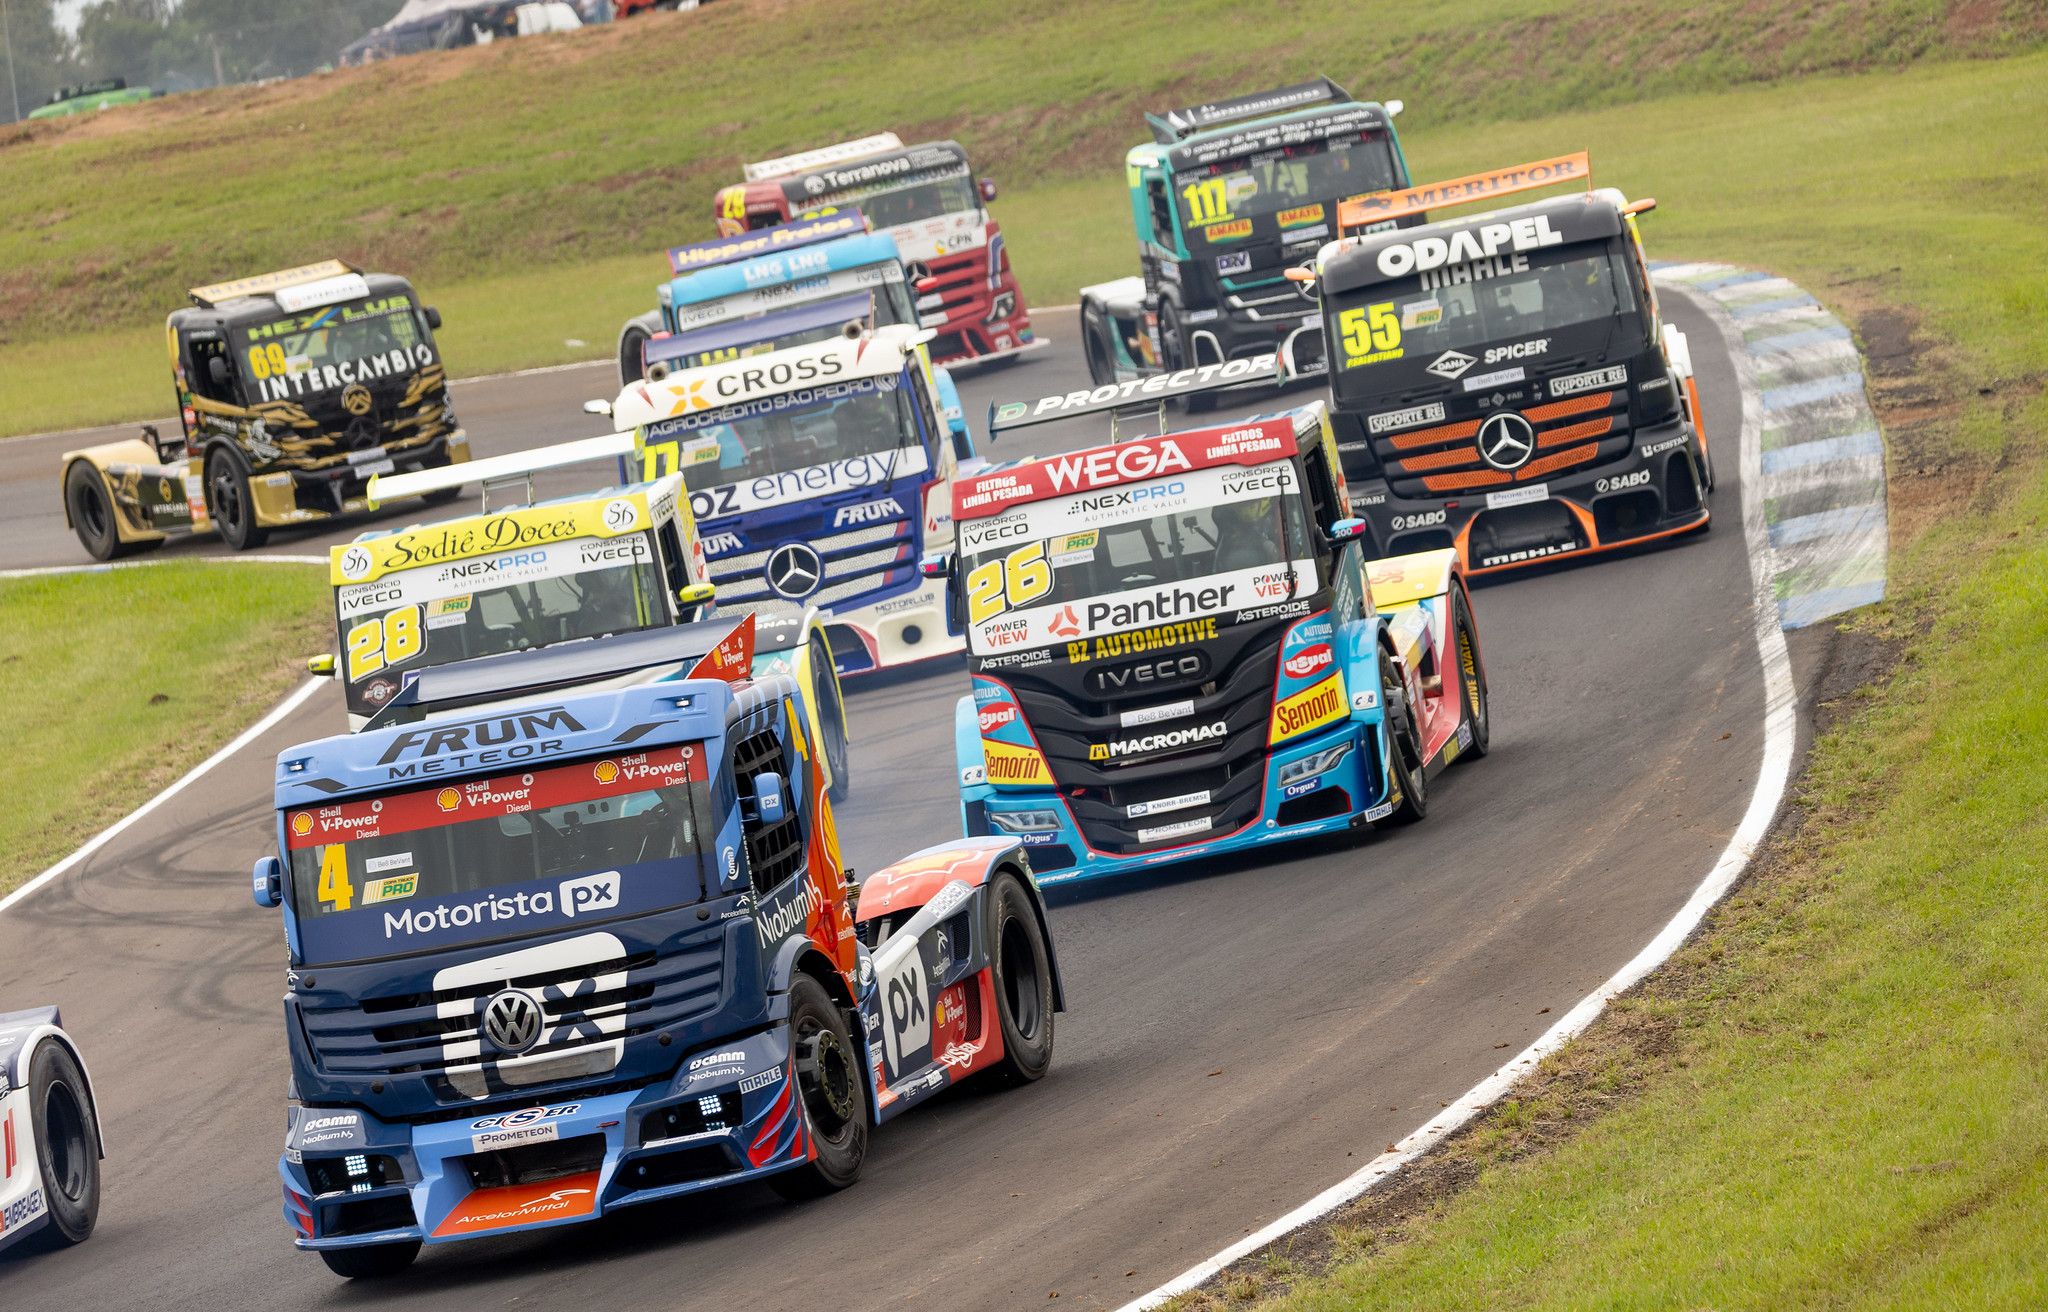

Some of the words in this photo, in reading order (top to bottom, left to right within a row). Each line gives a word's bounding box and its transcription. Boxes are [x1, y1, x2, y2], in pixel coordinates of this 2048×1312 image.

[824, 157, 911, 188] Terranova
[1404, 159, 1577, 209] MERITOR
[1183, 178, 1227, 220] 117
[678, 236, 768, 265] Hipper
[772, 217, 854, 244] Freios
[948, 233, 972, 248] CPN
[1377, 214, 1563, 277] ODAPEL
[744, 260, 784, 282] LNG
[788, 251, 829, 271] LNG
[1420, 253, 1530, 292] MAHLE
[1340, 302, 1401, 356] 55
[249, 343, 287, 380] 69
[1484, 338, 1549, 365] SPICER
[258, 344, 433, 402] INTERCAMBIO
[716, 353, 843, 397] CROSS
[1437, 358, 1467, 371] DANA
[1033, 353, 1277, 416] PROTECTOR
[650, 401, 772, 438] AGROCRÉDITO
[773, 385, 812, 411] SÃO
[812, 378, 875, 401] PEDRO
[1206, 444, 1239, 460] LINHA
[1239, 438, 1282, 454] PESADA
[1221, 428, 1264, 445] FILTROS
[752, 450, 896, 501] energy
[1045, 440, 1192, 493] WEGA
[1222, 465, 1290, 482] CONSÓRCIO
[962, 493, 993, 510] LINHA
[993, 484, 1034, 503] PESADA
[976, 476, 1017, 493] FILTROS
[1082, 481, 1185, 513] NEXPRO
[1223, 475, 1291, 496] IVECO
[833, 497, 905, 528] FRUM
[963, 512, 1028, 534] CONSÓRCIO
[1085, 505, 1149, 523] AUTHENTIC
[1153, 498, 1188, 510] VALUE
[382, 530, 475, 569] Sodiê
[480, 515, 577, 551] Doces
[580, 535, 644, 551] CONSÓRCIO
[700, 532, 744, 556] UM
[964, 523, 1029, 548] IVECO
[1067, 536, 1095, 550] PRO
[452, 550, 547, 579] NEXPRO
[581, 545, 645, 564] IVECO
[1483, 541, 1577, 567] MAHLE
[342, 579, 401, 598] CONSÓRCIO
[454, 572, 508, 590] AUTHENTIC
[518, 565, 550, 578] VALUE
[967, 539, 1056, 627] 26
[1252, 570, 1298, 586] POWER
[1254, 580, 1299, 599] VIEW
[343, 589, 402, 611] IVECO
[443, 600, 469, 612] PRO
[876, 592, 935, 614] MOTORLUB
[1088, 584, 1235, 631] Panther
[1235, 600, 1310, 625] ASTEROIDE
[985, 619, 1028, 636] POWER
[986, 629, 1028, 648] VIEW
[347, 603, 428, 684] 28
[1067, 640, 1090, 665] BZ
[1096, 617, 1219, 660] AUTOMOTIVE
[979, 648, 1052, 672] ASTEROIDE
[1098, 656, 1200, 690] IVECO
[1158, 705, 1192, 719] BeVant
[1277, 686, 1340, 735] Semorin
[376, 706, 587, 766] FRUM
[785, 697, 809, 762] 4
[1110, 721, 1228, 757] MACROMAQ
[389, 739, 564, 780] METEOR
[621, 752, 647, 767] Shell
[622, 759, 690, 781] V-Power
[984, 749, 1041, 779] Semorin
[465, 781, 490, 795] Shell
[665, 773, 692, 787] Diesel
[1287, 780, 1316, 796] Orgus
[466, 786, 531, 808] V-Power
[506, 801, 532, 815] Diesel
[1152, 793, 1208, 809] KNORR-BREMSE
[319, 805, 342, 819] Shell
[320, 814, 380, 833] V-Power
[1367, 803, 1392, 821] MAHLE
[356, 827, 380, 840] Diesel
[1023, 834, 1051, 845] Orgus
[1144, 818, 1207, 836] PROMETEON
[390, 856, 411, 867] BeVant
[318, 842, 354, 911] 4
[382, 881, 414, 897] PRO
[384, 891, 554, 939] Motorista
[756, 892, 808, 949] Niobium
[689, 1067, 731, 1082] Niobium
[741, 1069, 781, 1093] MAHLE
[471, 1104, 581, 1129] CISER
[302, 1132, 340, 1146] Niobium
[478, 1126, 553, 1144] PROMETEON
[4, 1186, 45, 1230] EMBREAGEX
[456, 1200, 570, 1225] ArcelorMittal
